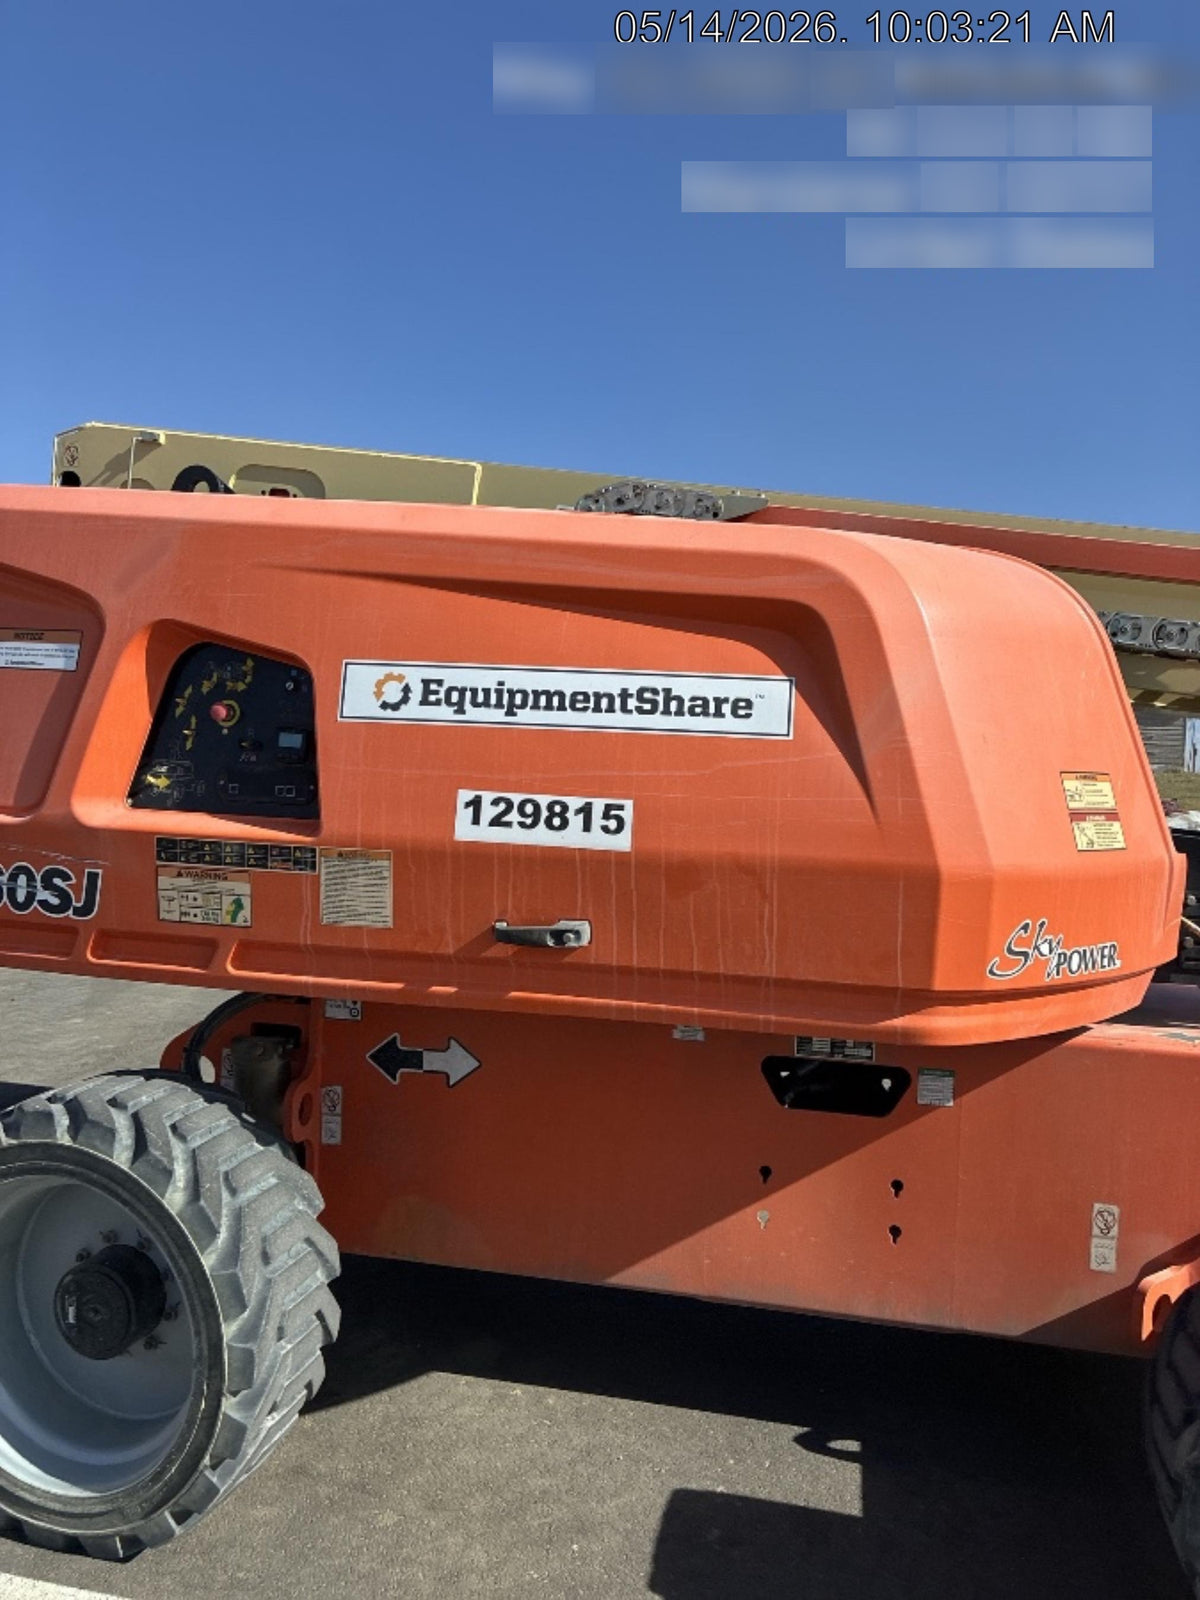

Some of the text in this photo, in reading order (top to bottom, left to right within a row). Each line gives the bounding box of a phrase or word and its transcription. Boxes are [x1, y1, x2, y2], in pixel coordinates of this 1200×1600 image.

[418, 678, 754, 719] EquipmentShare
[463, 794, 626, 836] 129815
[0, 863, 102, 920] 0SJ
[987, 919, 1119, 980] Sky POWER
